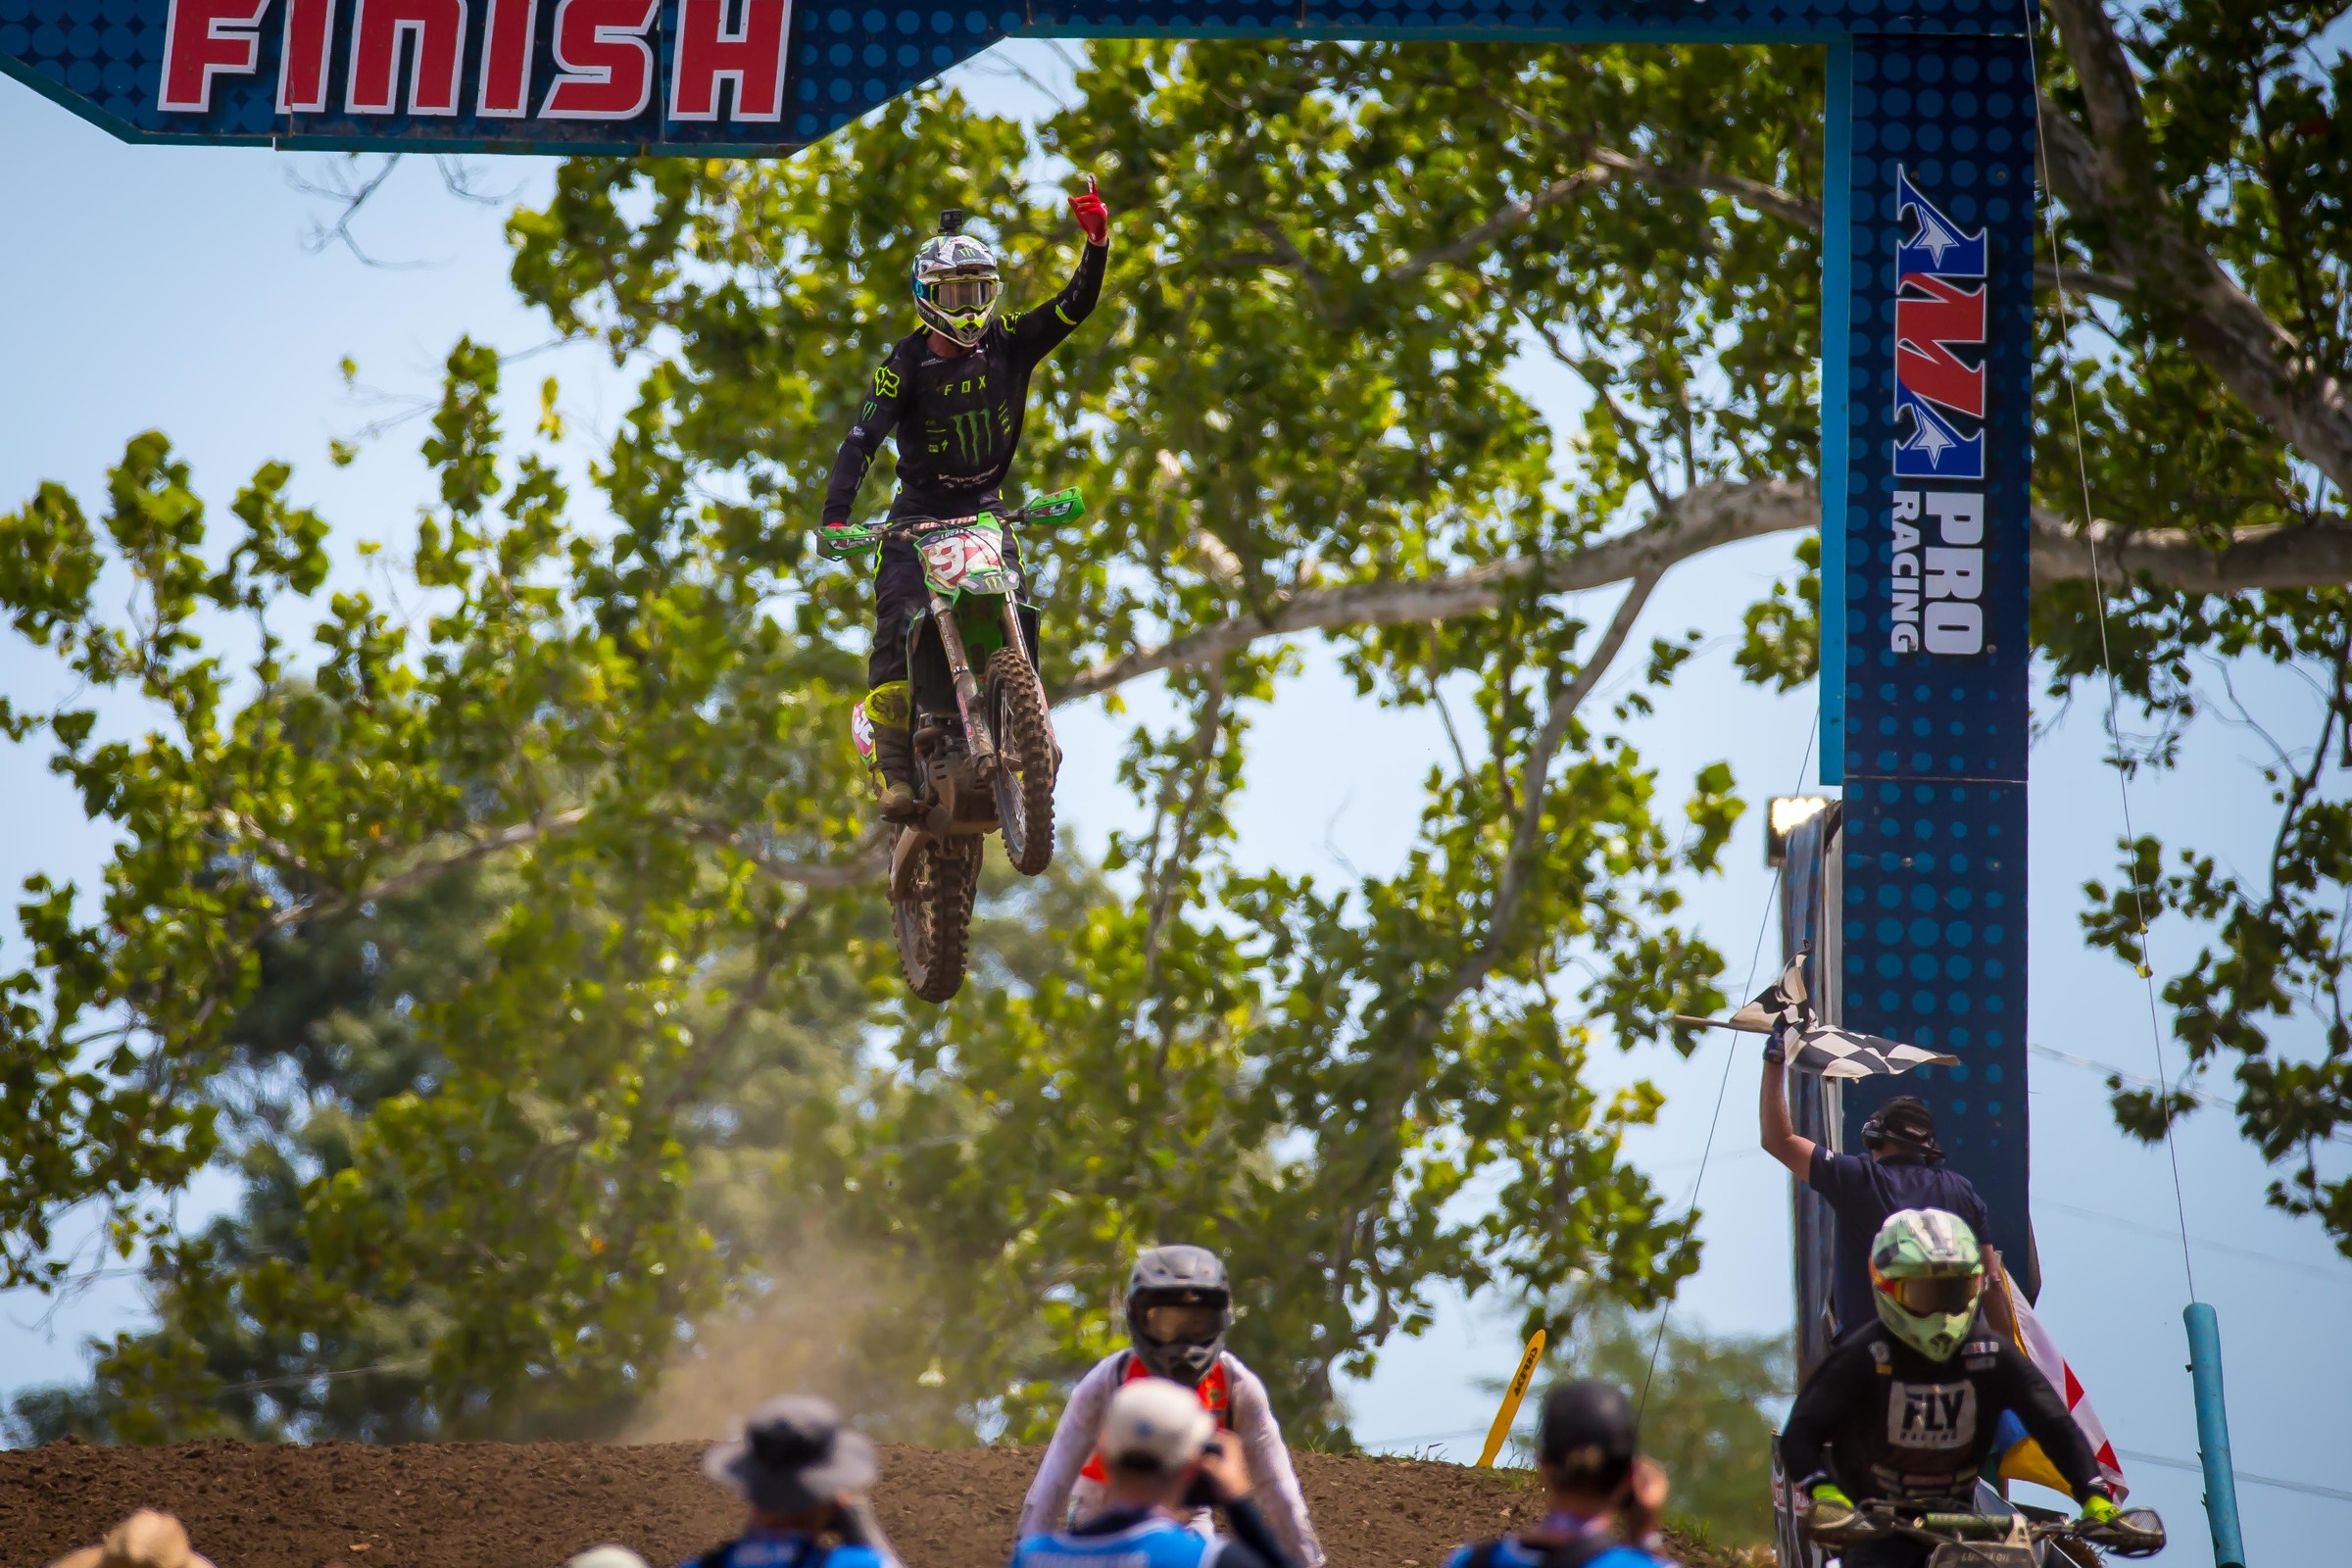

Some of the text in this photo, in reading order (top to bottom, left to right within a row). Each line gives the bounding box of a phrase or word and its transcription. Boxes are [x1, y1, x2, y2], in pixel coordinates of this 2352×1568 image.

[157, 0, 791, 122] FINISH
[944, 375, 986, 396] FOX
[1892, 163, 1987, 479] AMA
[1890, 490, 1920, 655] RACING
[1924, 491, 1984, 656] PRO
[1901, 1389, 1965, 1431] FLY
